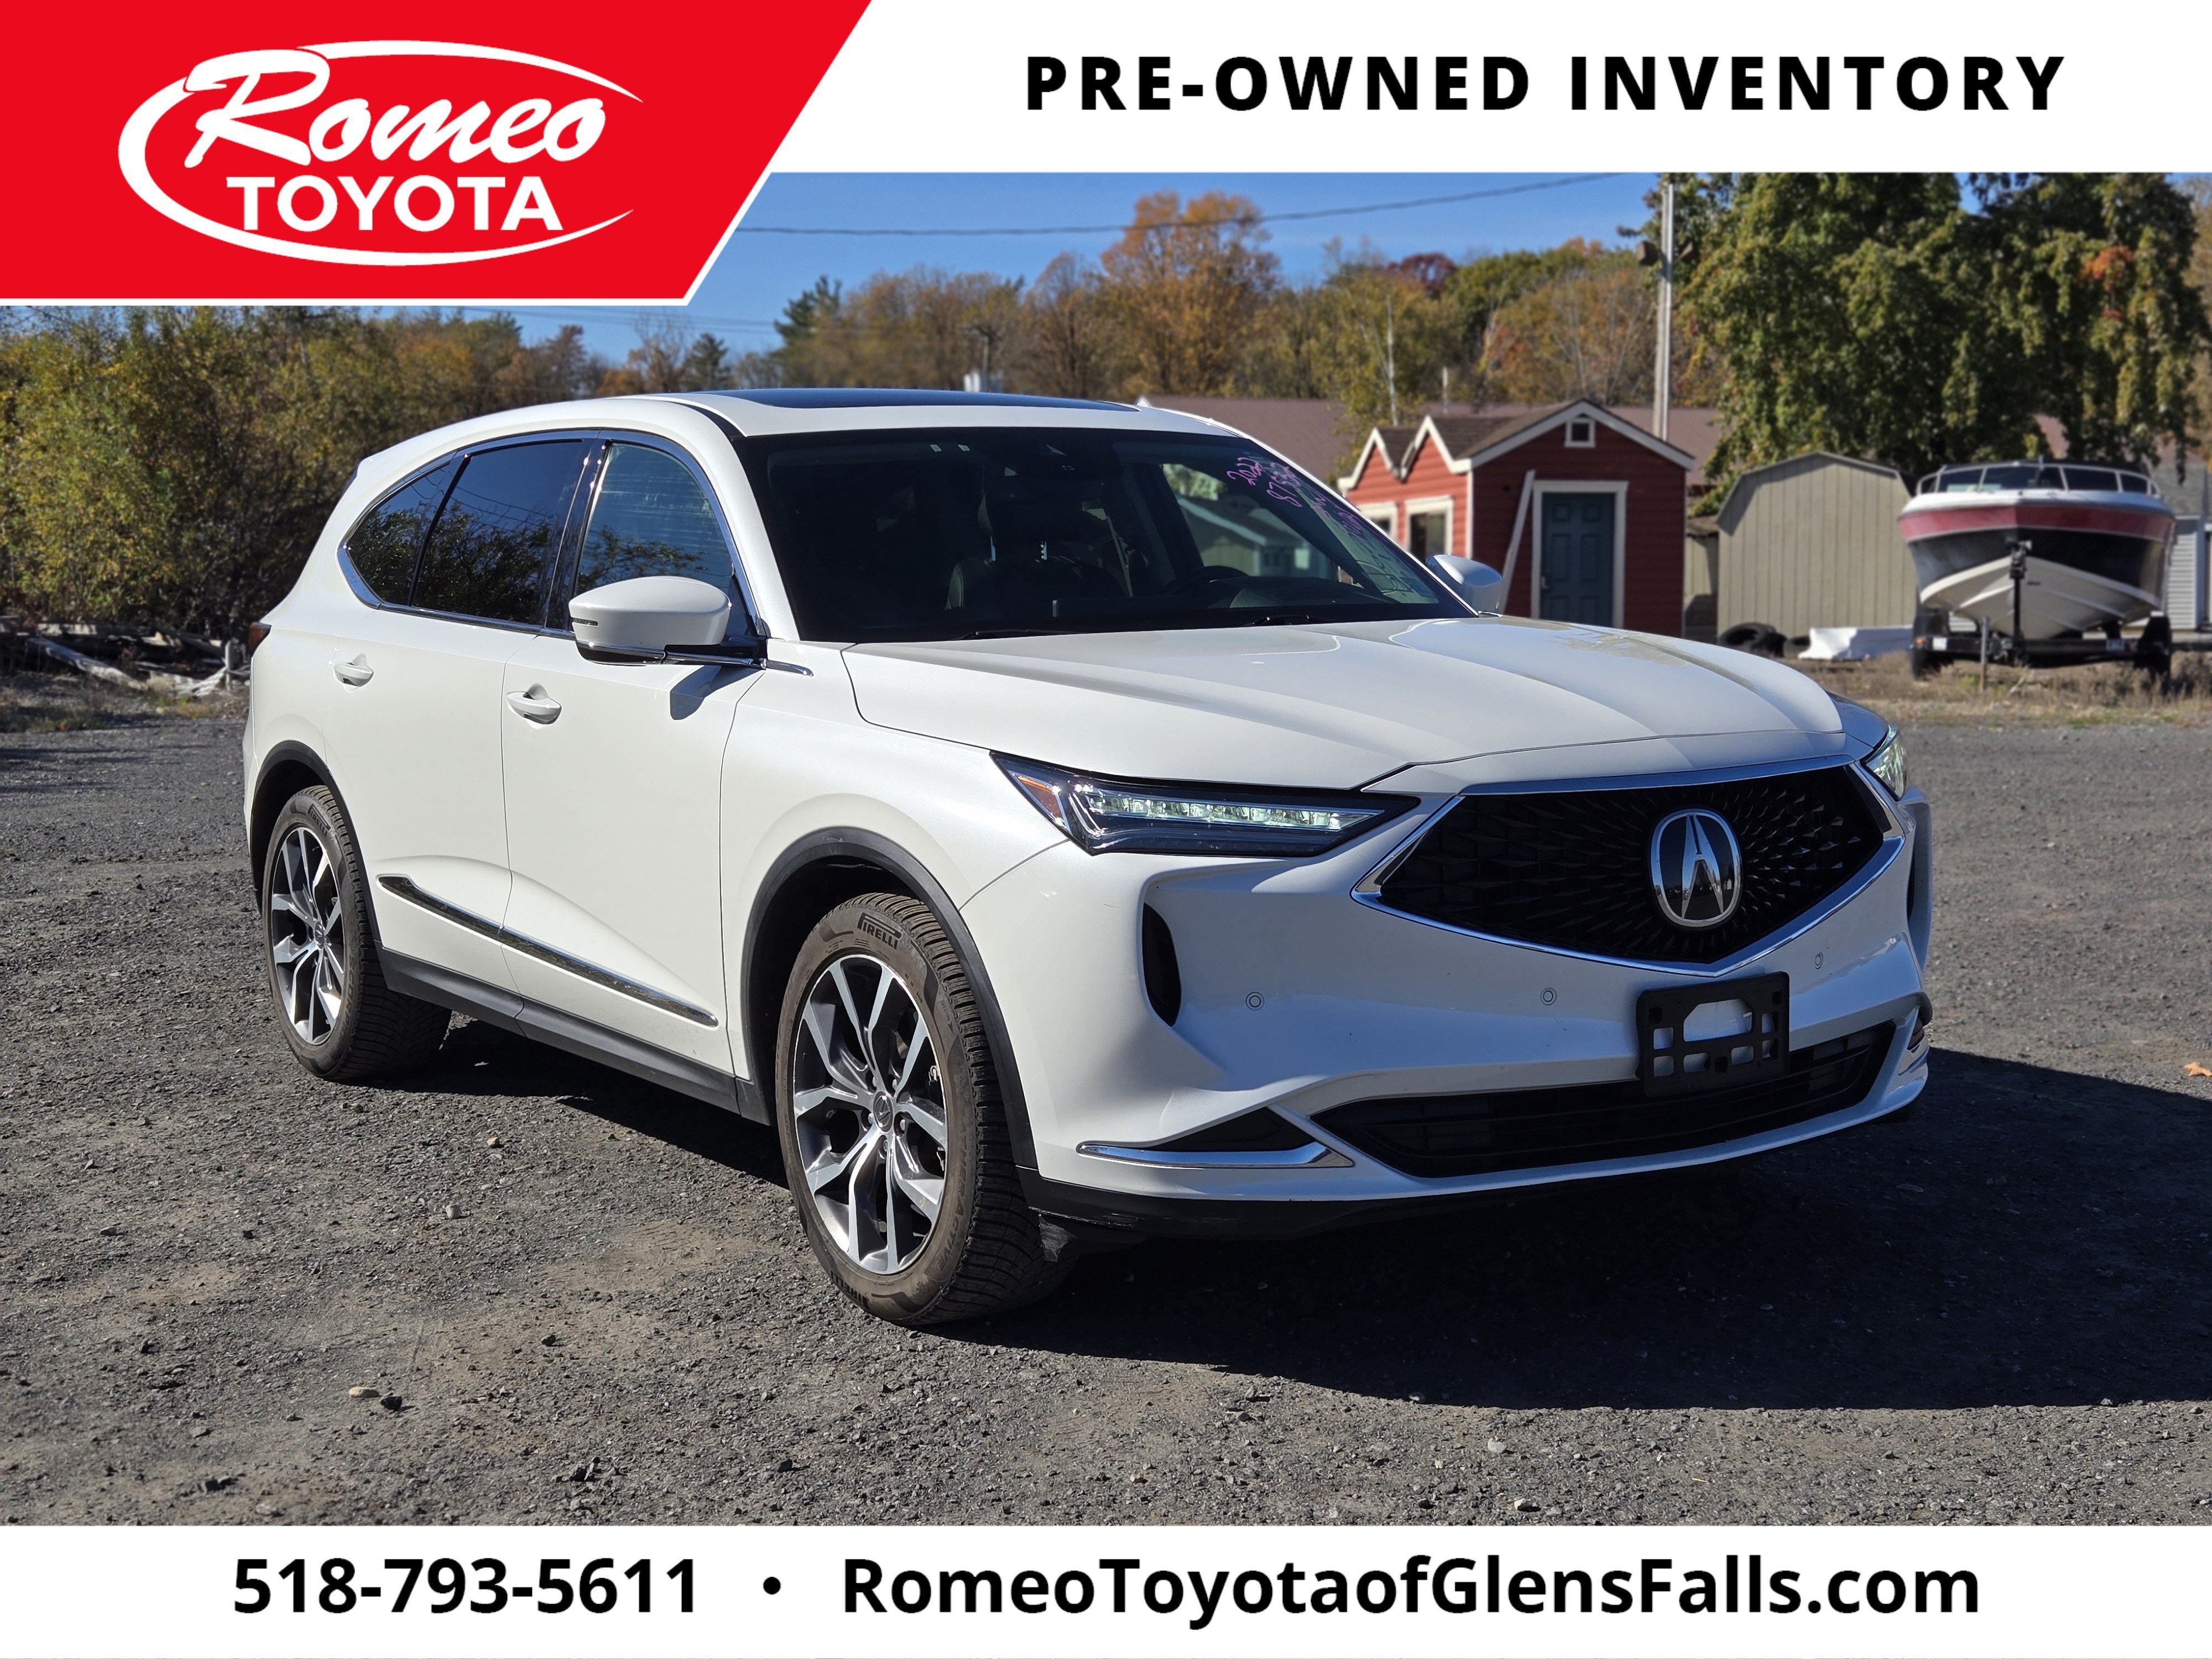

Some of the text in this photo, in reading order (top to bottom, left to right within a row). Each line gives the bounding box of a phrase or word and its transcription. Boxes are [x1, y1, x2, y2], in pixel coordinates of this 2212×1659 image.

[307, 803, 331, 838] PIRELLI
[857, 912, 902, 950] PIRELLI
[337, 954, 354, 1045] SCORPIO
[938, 1094, 967, 1272] EATHERACTIVE
